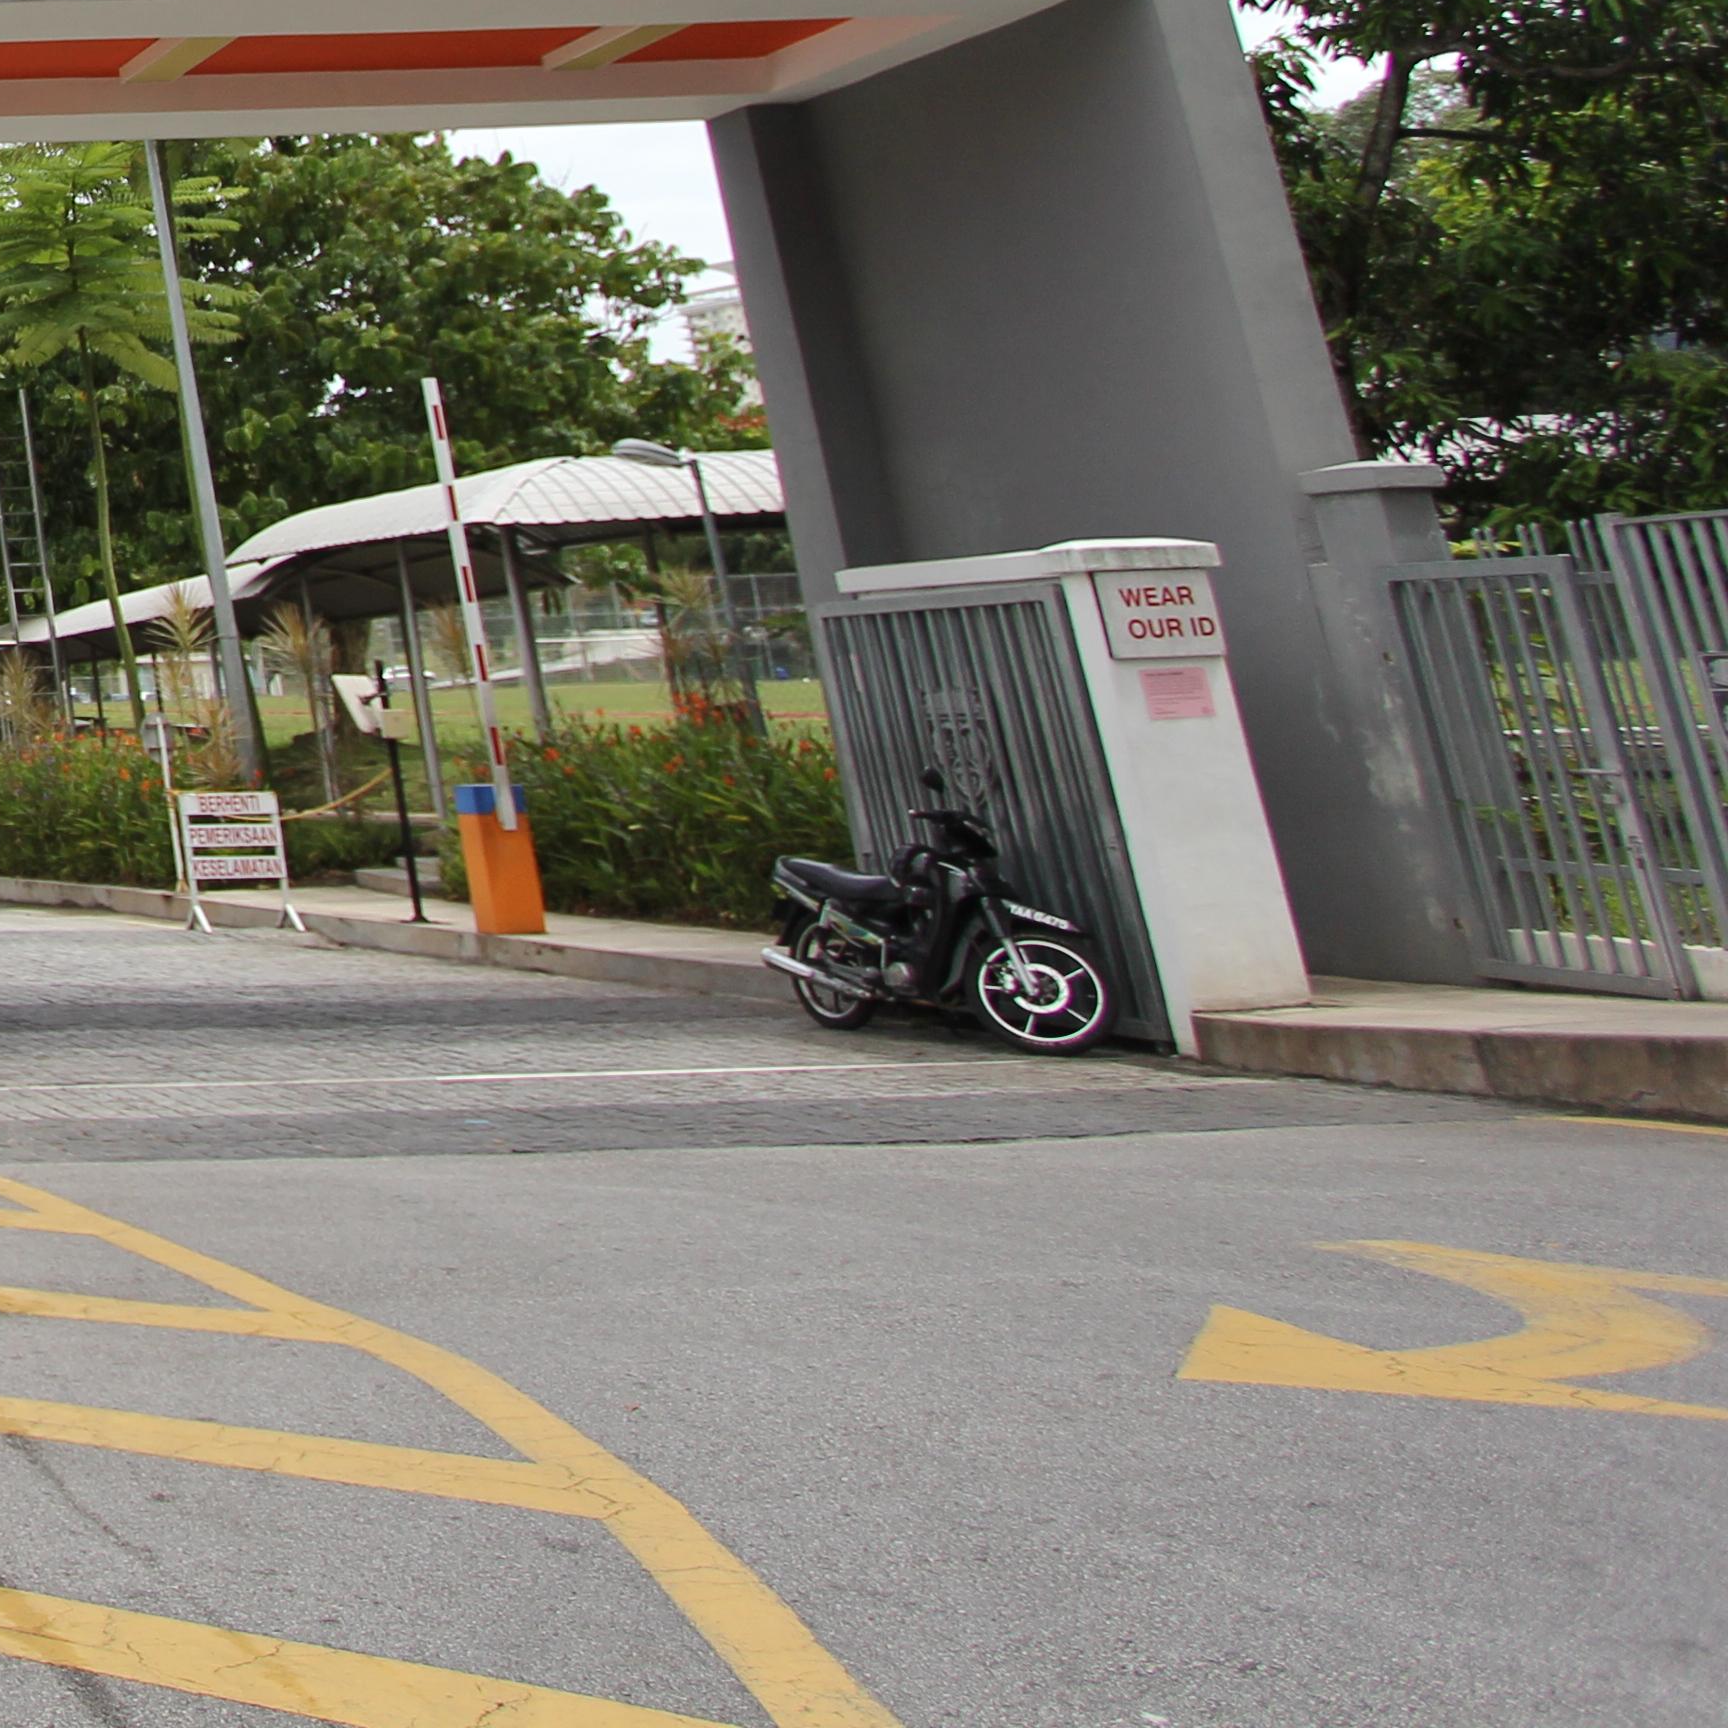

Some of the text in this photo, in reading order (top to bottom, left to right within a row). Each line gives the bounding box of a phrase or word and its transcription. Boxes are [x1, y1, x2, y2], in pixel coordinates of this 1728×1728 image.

[1118, 586, 1194, 607] WEAR
[1128, 617, 1215, 639] OUR ID
[199, 795, 260, 812] BERHENTI
[189, 827, 277, 844] PEMERIKSAAN
[193, 859, 282, 876] KESELAMATAN
